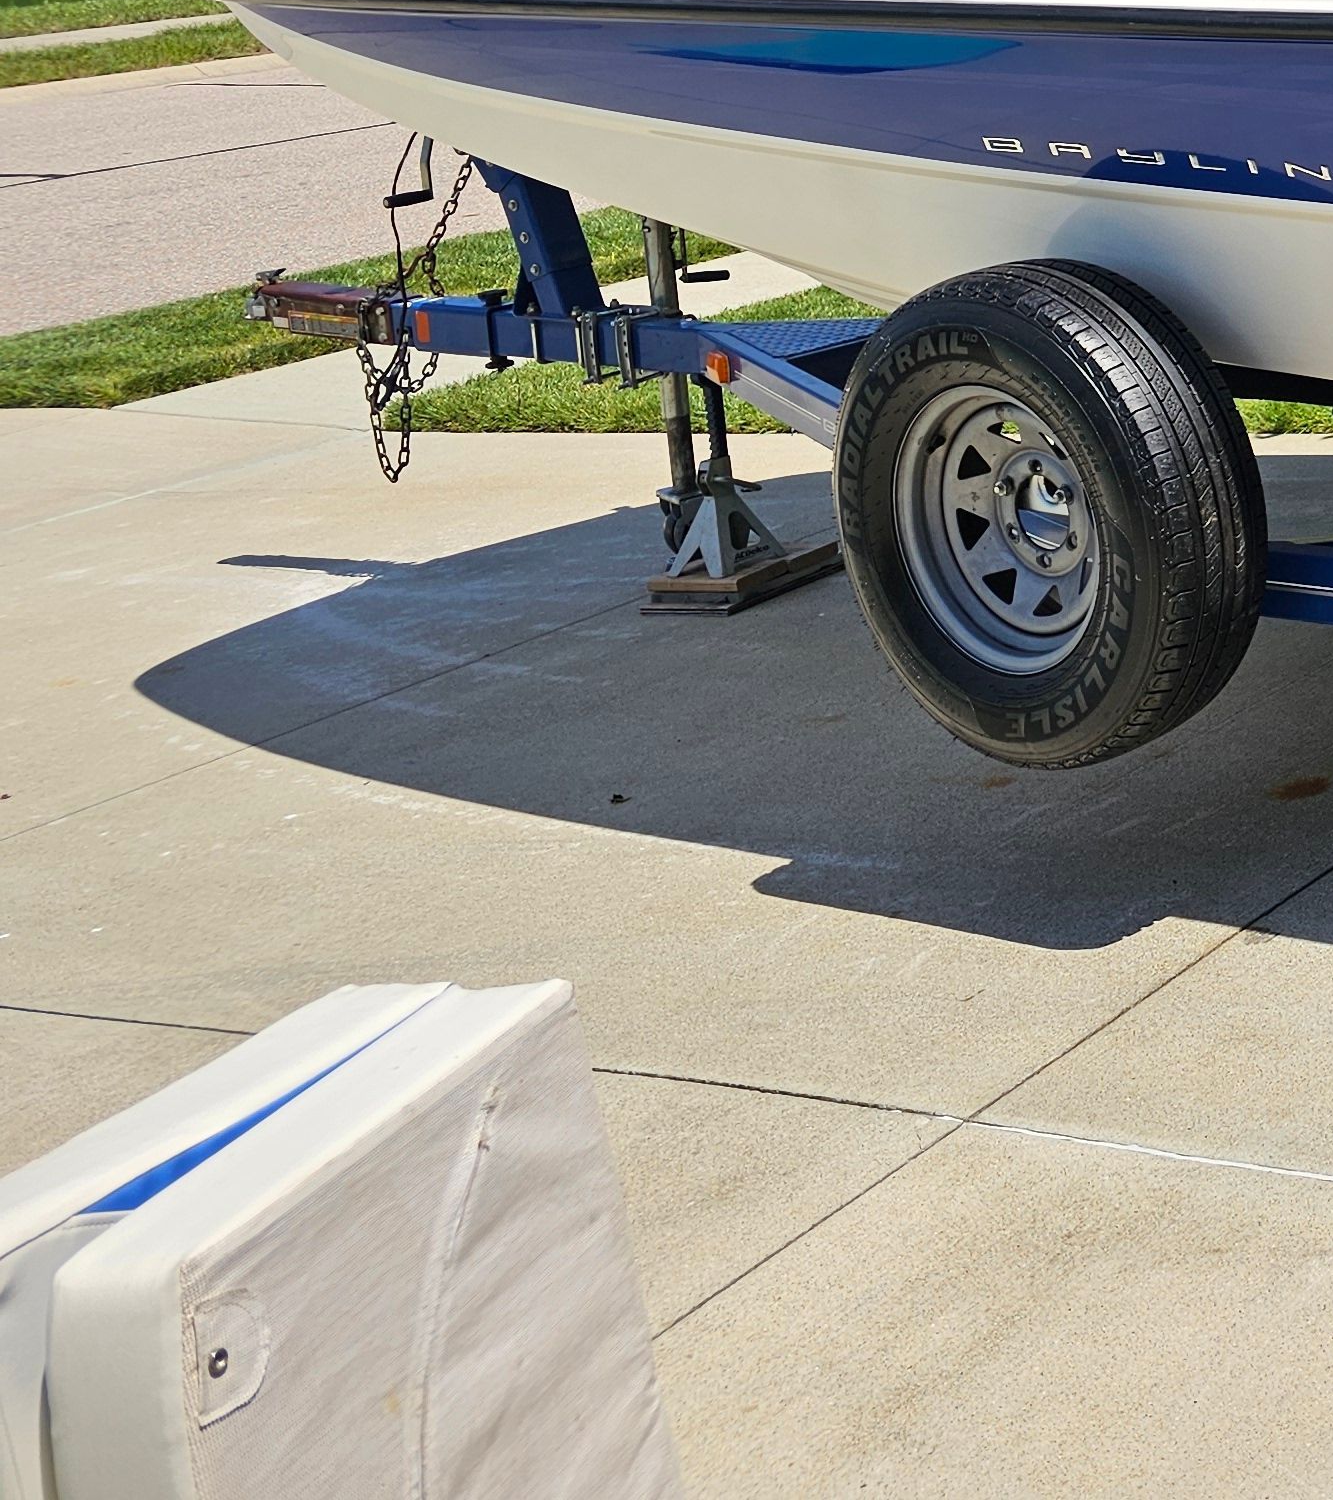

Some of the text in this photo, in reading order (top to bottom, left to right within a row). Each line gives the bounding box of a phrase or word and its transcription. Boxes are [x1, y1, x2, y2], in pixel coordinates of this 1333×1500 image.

[842, 384, 884, 538] RADIAL
[877, 331, 968, 384] TRAIL
[1005, 553, 1131, 738] CARLISLE
